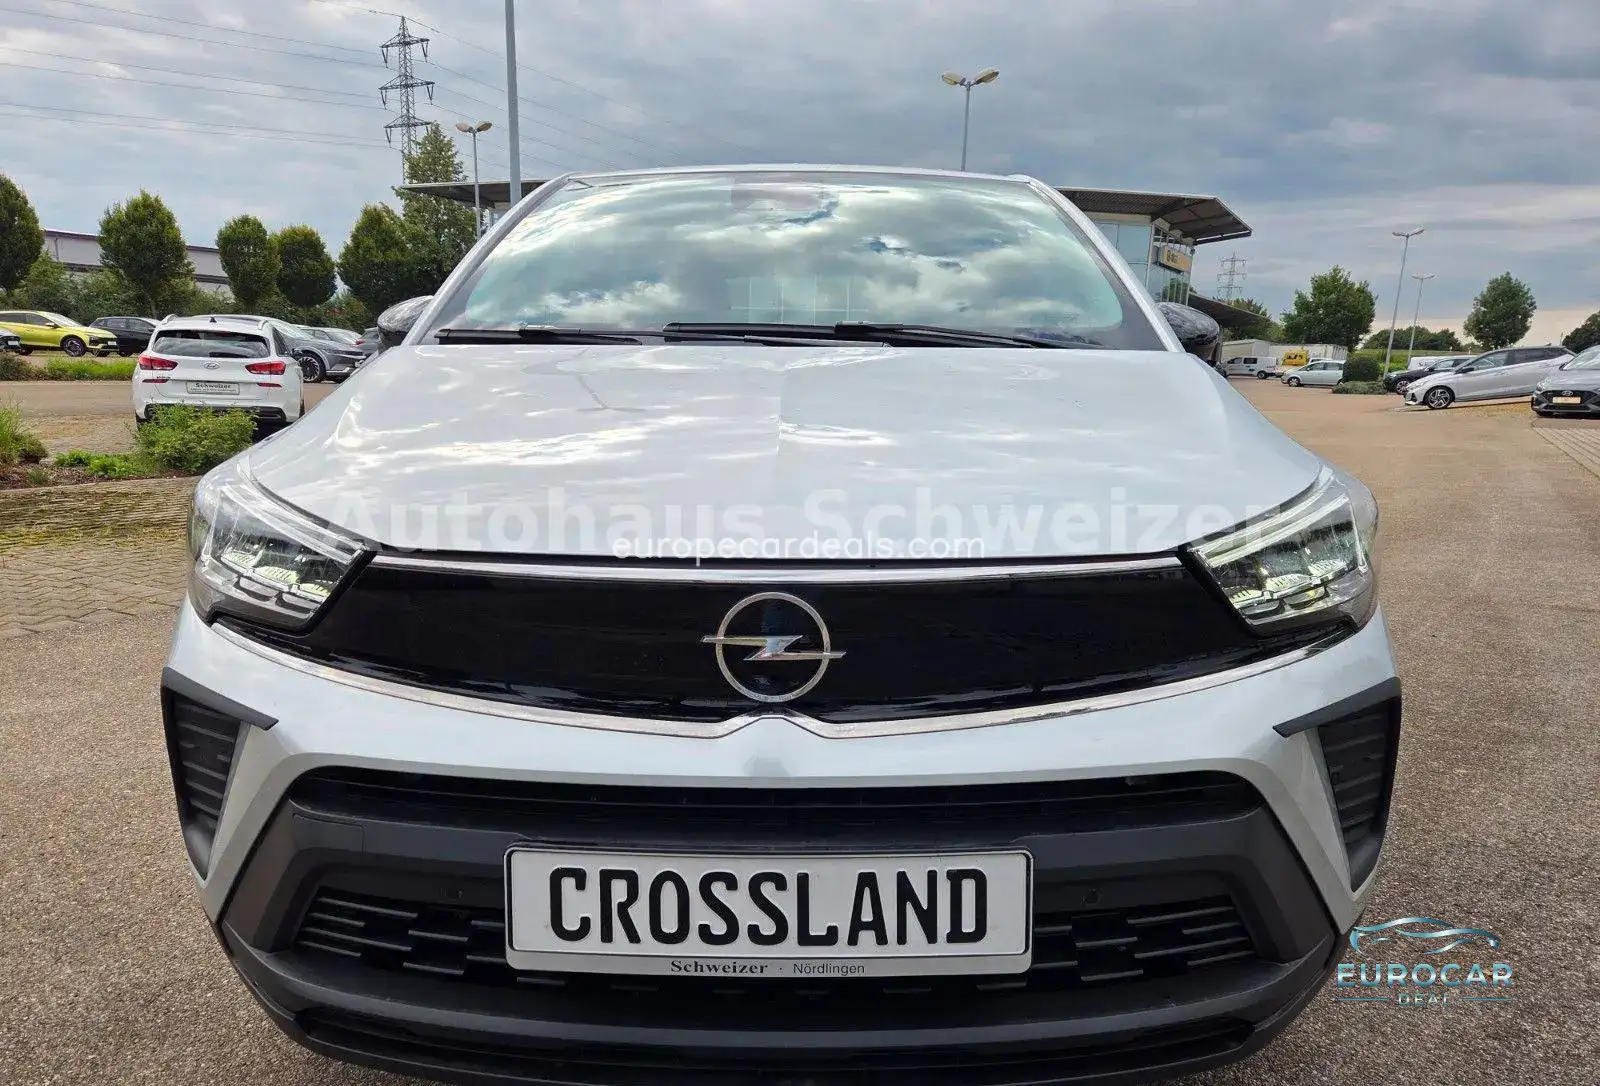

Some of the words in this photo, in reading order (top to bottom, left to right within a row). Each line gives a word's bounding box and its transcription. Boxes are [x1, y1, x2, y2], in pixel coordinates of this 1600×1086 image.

[548, 867, 988, 946] CROSSLAND
[671, 960, 768, 974] Schweizer
[793, 963, 865, 976] Nördlingen
